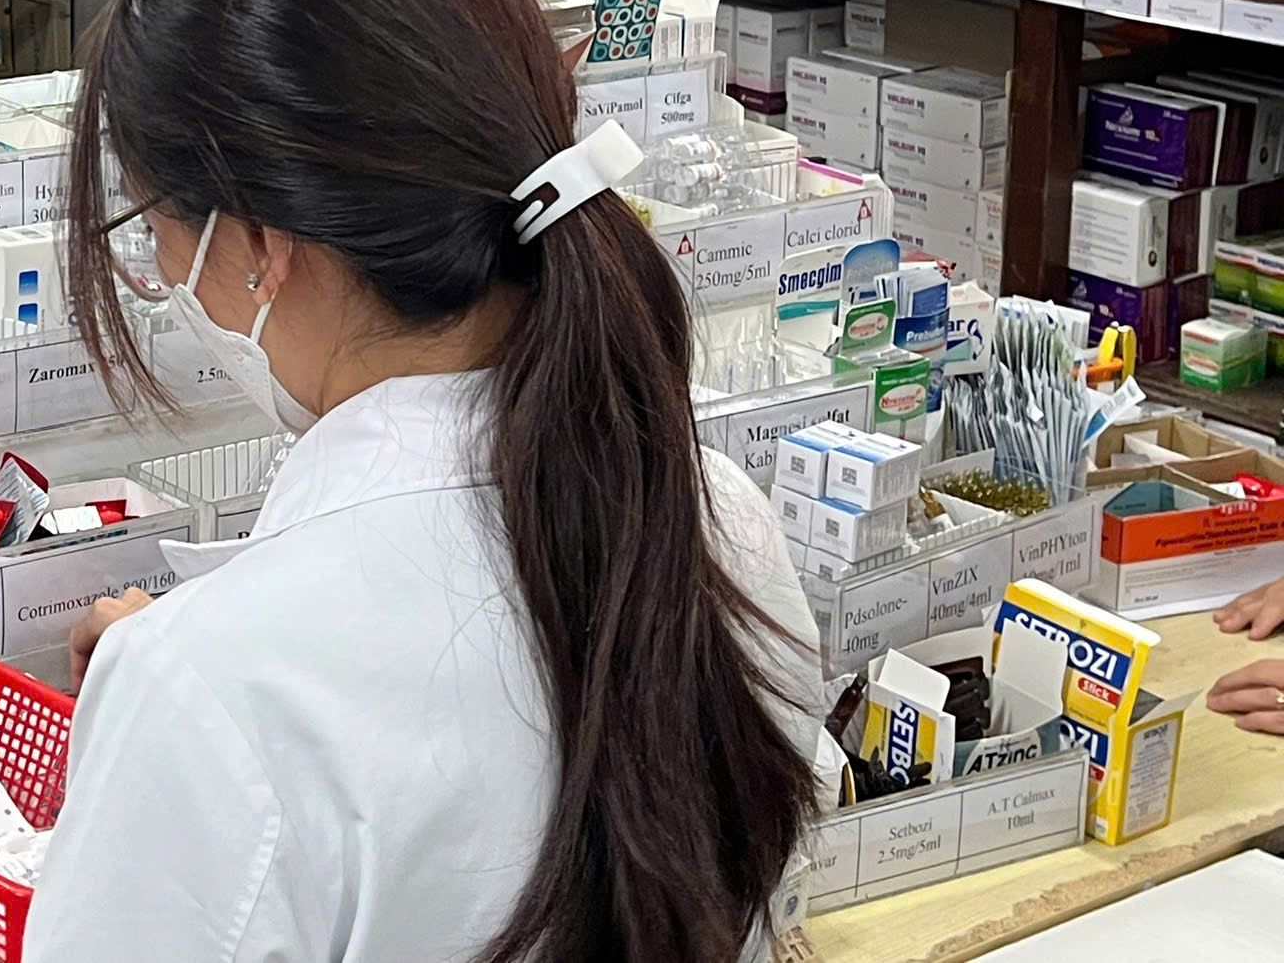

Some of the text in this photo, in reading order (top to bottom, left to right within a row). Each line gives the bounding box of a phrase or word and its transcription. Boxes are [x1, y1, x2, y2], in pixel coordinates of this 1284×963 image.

[584, 97, 643, 118] SaViPamol
[664, 91, 692, 108] Cifga
[787, 222, 862, 248] Calci clorid
[696, 243, 753, 265] Cammic
[695, 260, 772, 291] 250mg/5ml
[778, 262, 842, 296] Smecgim
[28, 361, 96, 385] Zaromax
[1018, 528, 1088, 564] VinPHYton
[930, 564, 980, 596] VinZIX
[17, 585, 120, 623] Cotrimoxazole
[929, 585, 993, 623] 40mg/4ml
[842, 635, 880, 655] 40mg
[1014, 788, 1056, 809] Calmax
[888, 817, 933, 841] Setbozi
[877, 835, 942, 865] 2.5mg/5ml
